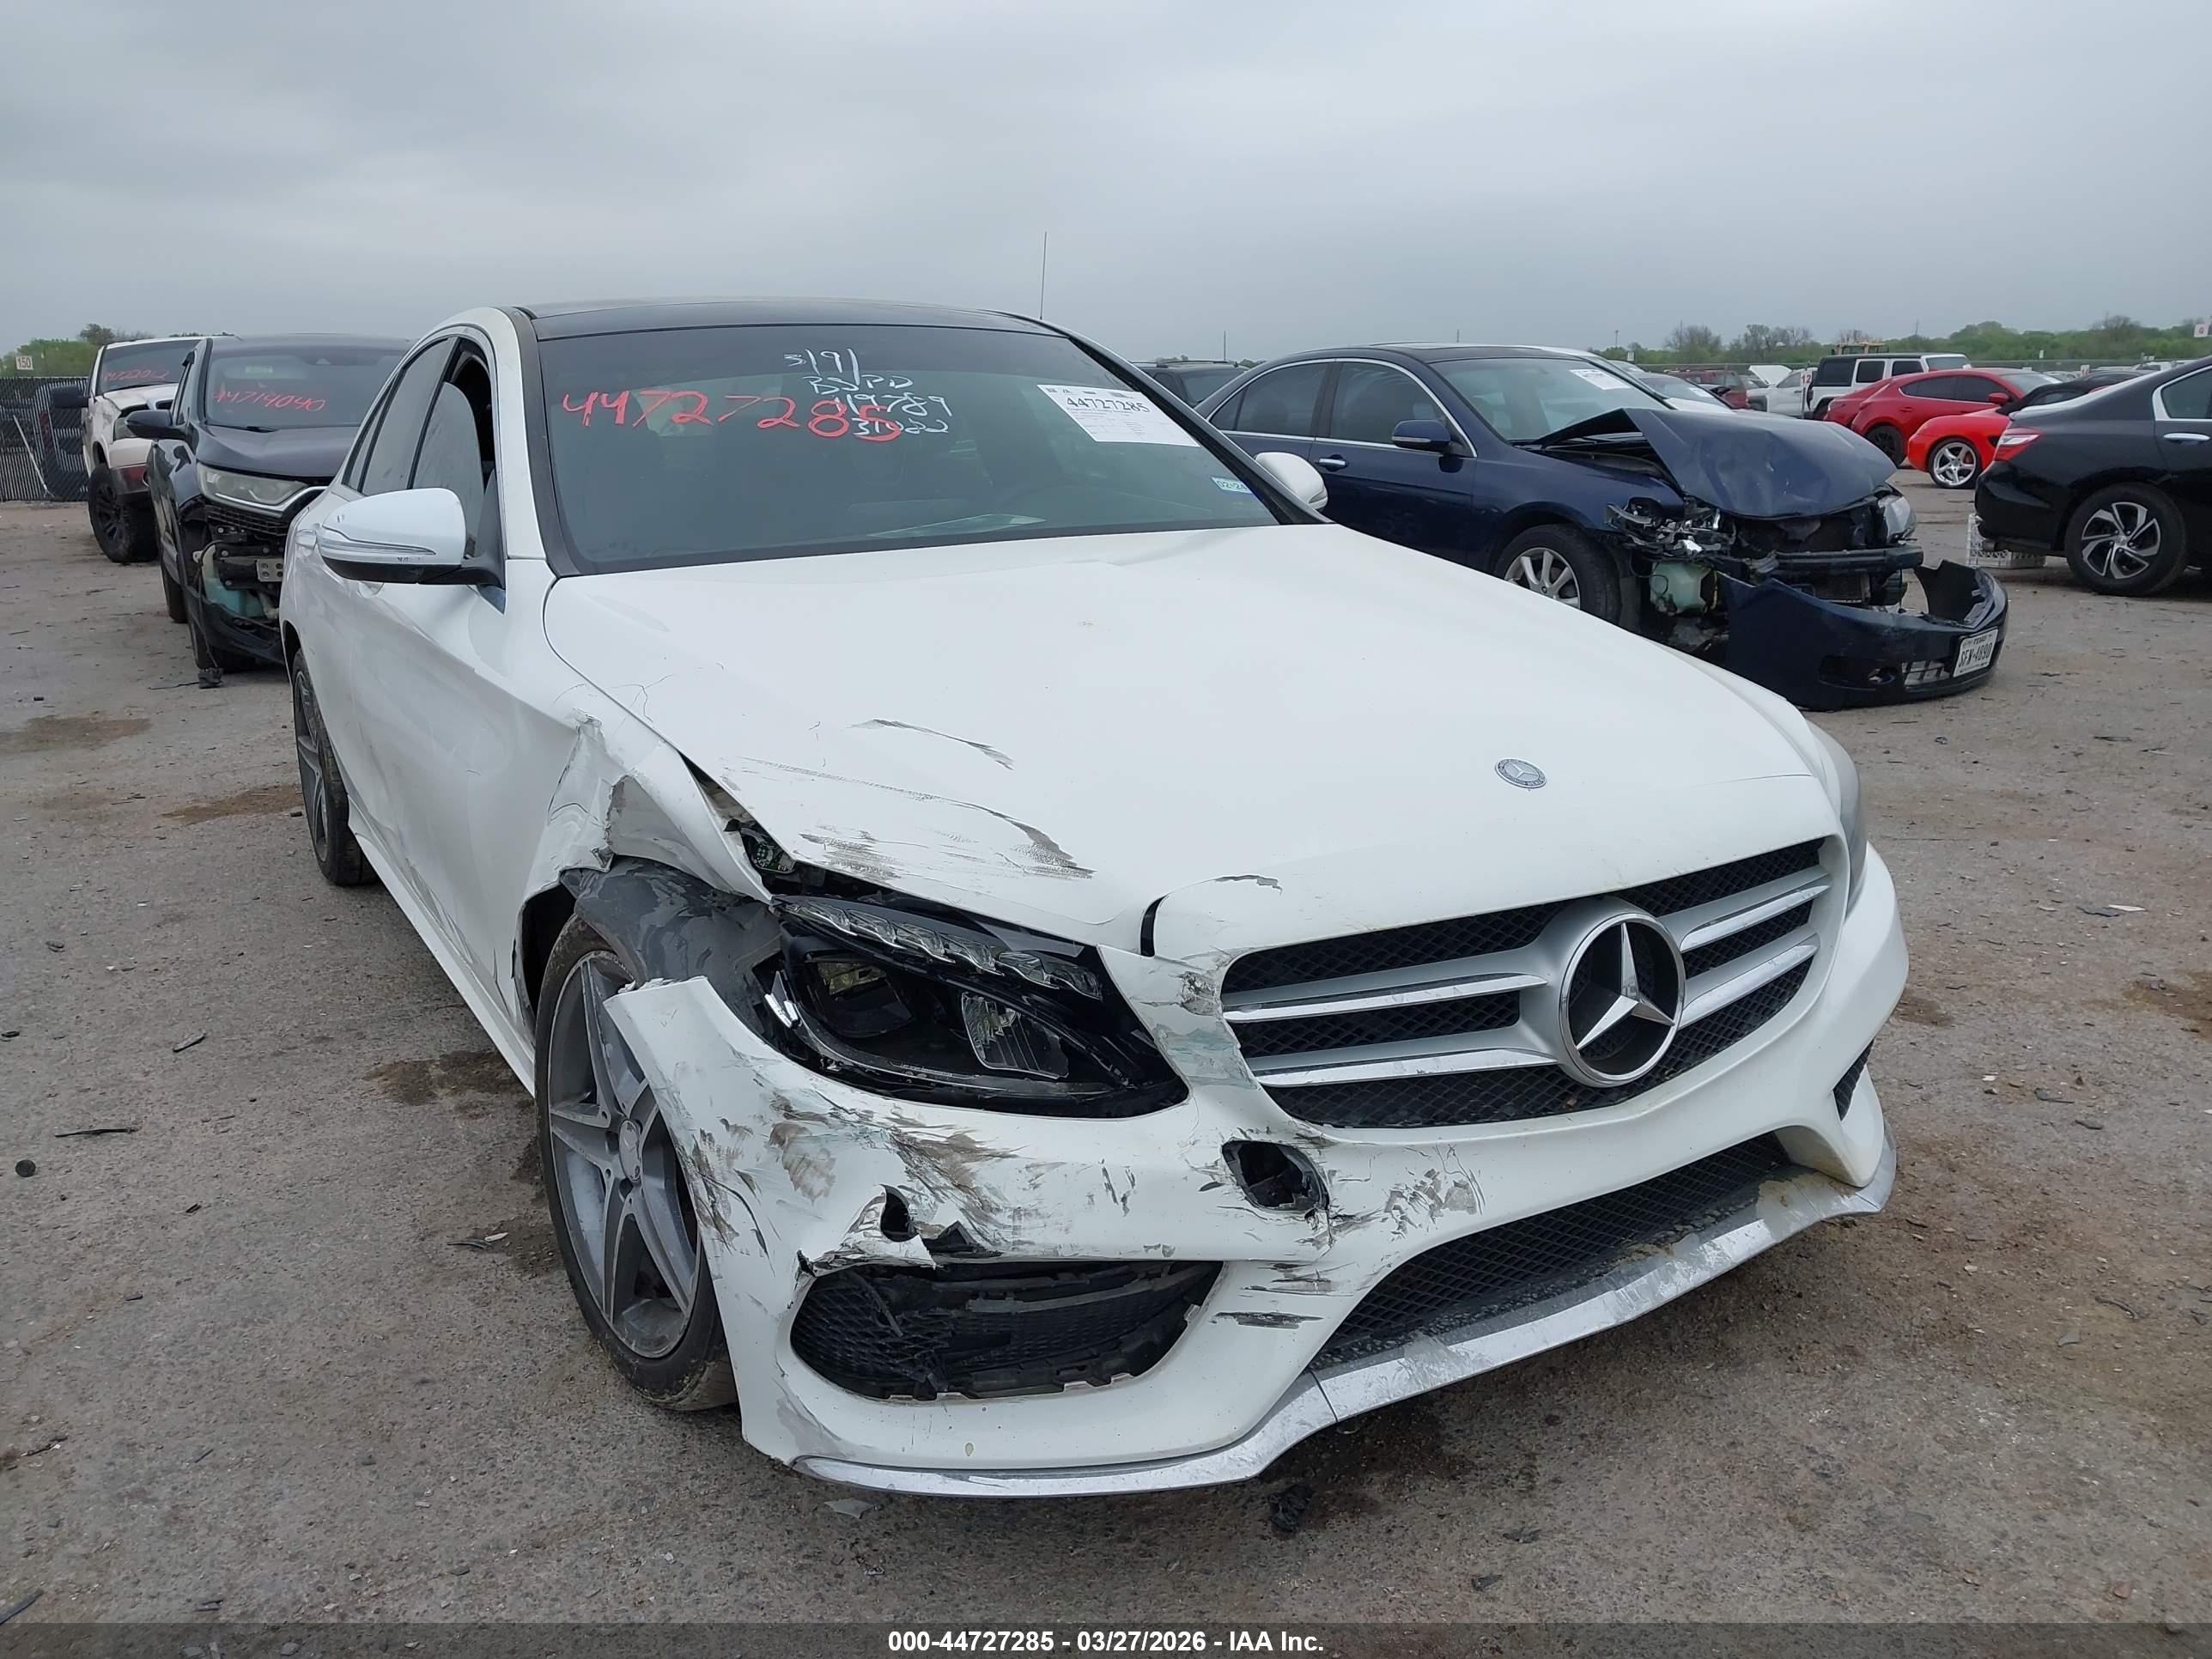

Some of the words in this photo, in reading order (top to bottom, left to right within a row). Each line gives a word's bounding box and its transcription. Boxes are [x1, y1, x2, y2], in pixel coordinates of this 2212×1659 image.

[1801, 374, 1812, 385] 12
[1066, 397, 1151, 413] 44727285
[562, 389, 903, 442] 44727285
